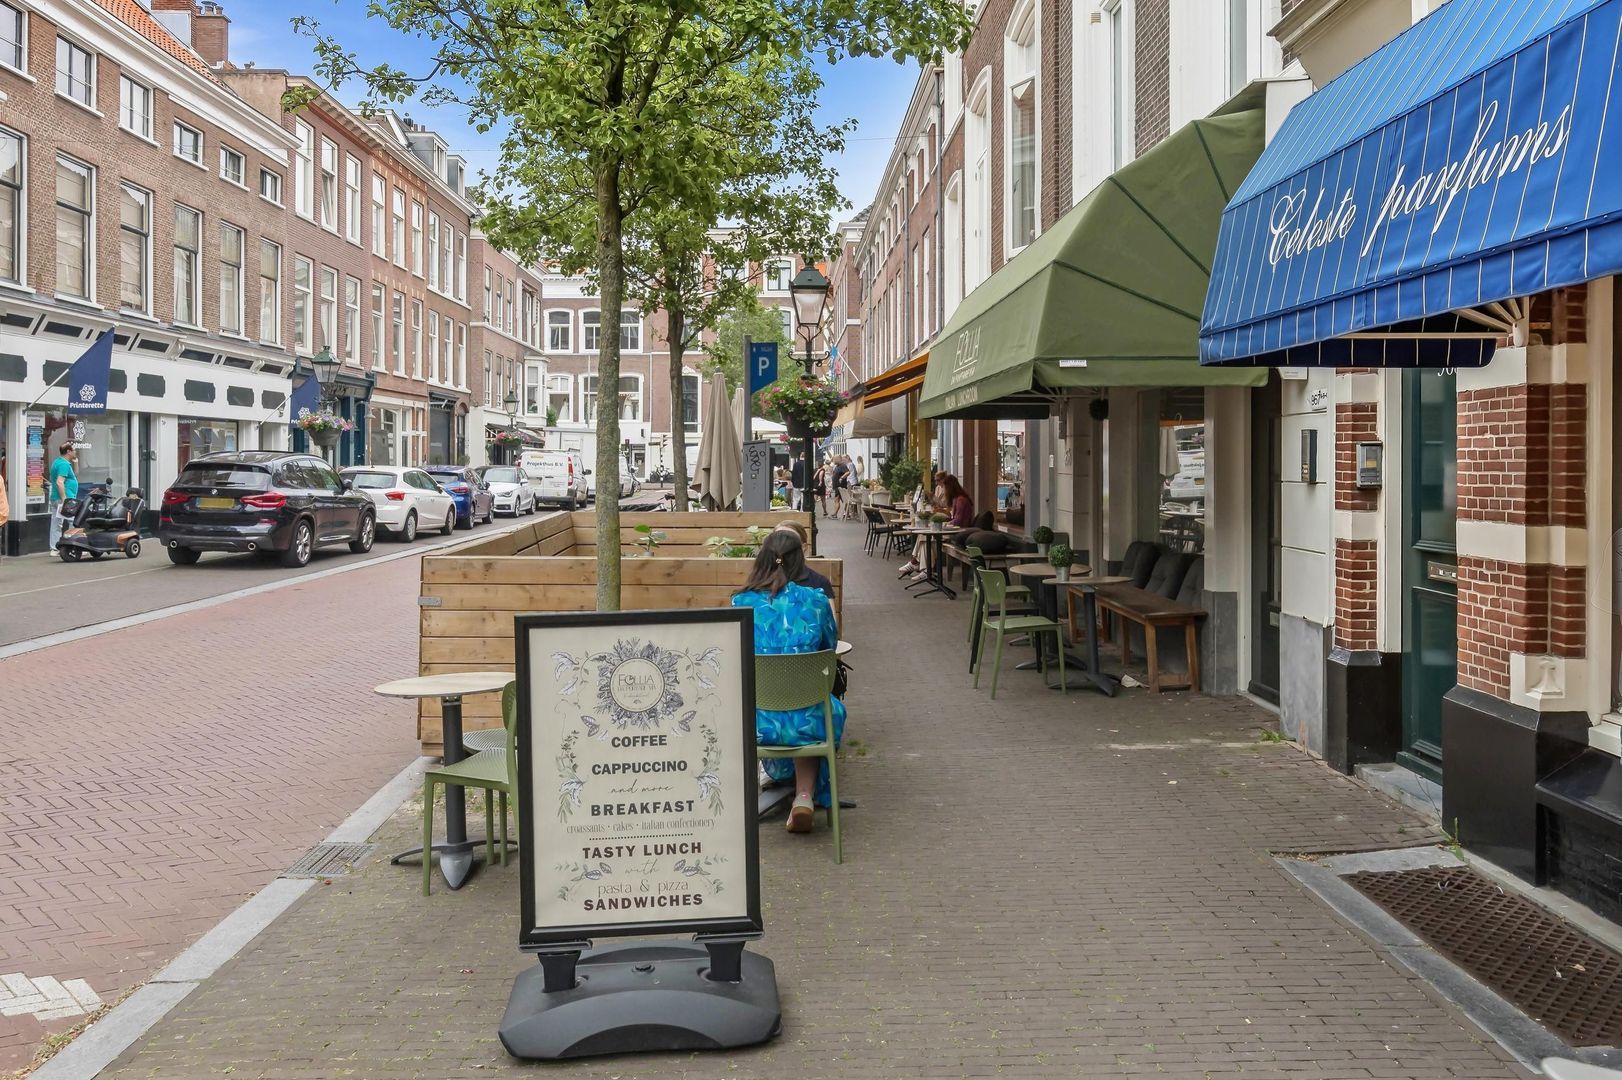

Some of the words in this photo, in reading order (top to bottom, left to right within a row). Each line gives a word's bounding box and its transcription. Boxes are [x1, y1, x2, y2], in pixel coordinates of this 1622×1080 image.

[1268, 189, 1357, 267] Celeste
[1362, 99, 1572, 257] parfums
[758, 356, 770, 377] P
[618, 673, 655, 685] FOLLIA
[611, 734, 667, 749] COFFEE
[591, 760, 688, 776] CAPPUCCINO
[610, 778, 638, 793] and
[641, 785, 674, 793] more
[591, 800, 695, 817] BREAKFAST
[612, 820, 634, 831] cakes
[641, 819, 665, 830] italian
[666, 817, 715, 829] confectionery
[582, 845, 636, 859] TASTY
[643, 842, 702, 856] LUNCH
[624, 859, 660, 875] with
[598, 882, 632, 897] pasta
[639, 879, 649, 892] &
[658, 880, 689, 895] pizza
[584, 893, 704, 911] SANDWICHES
